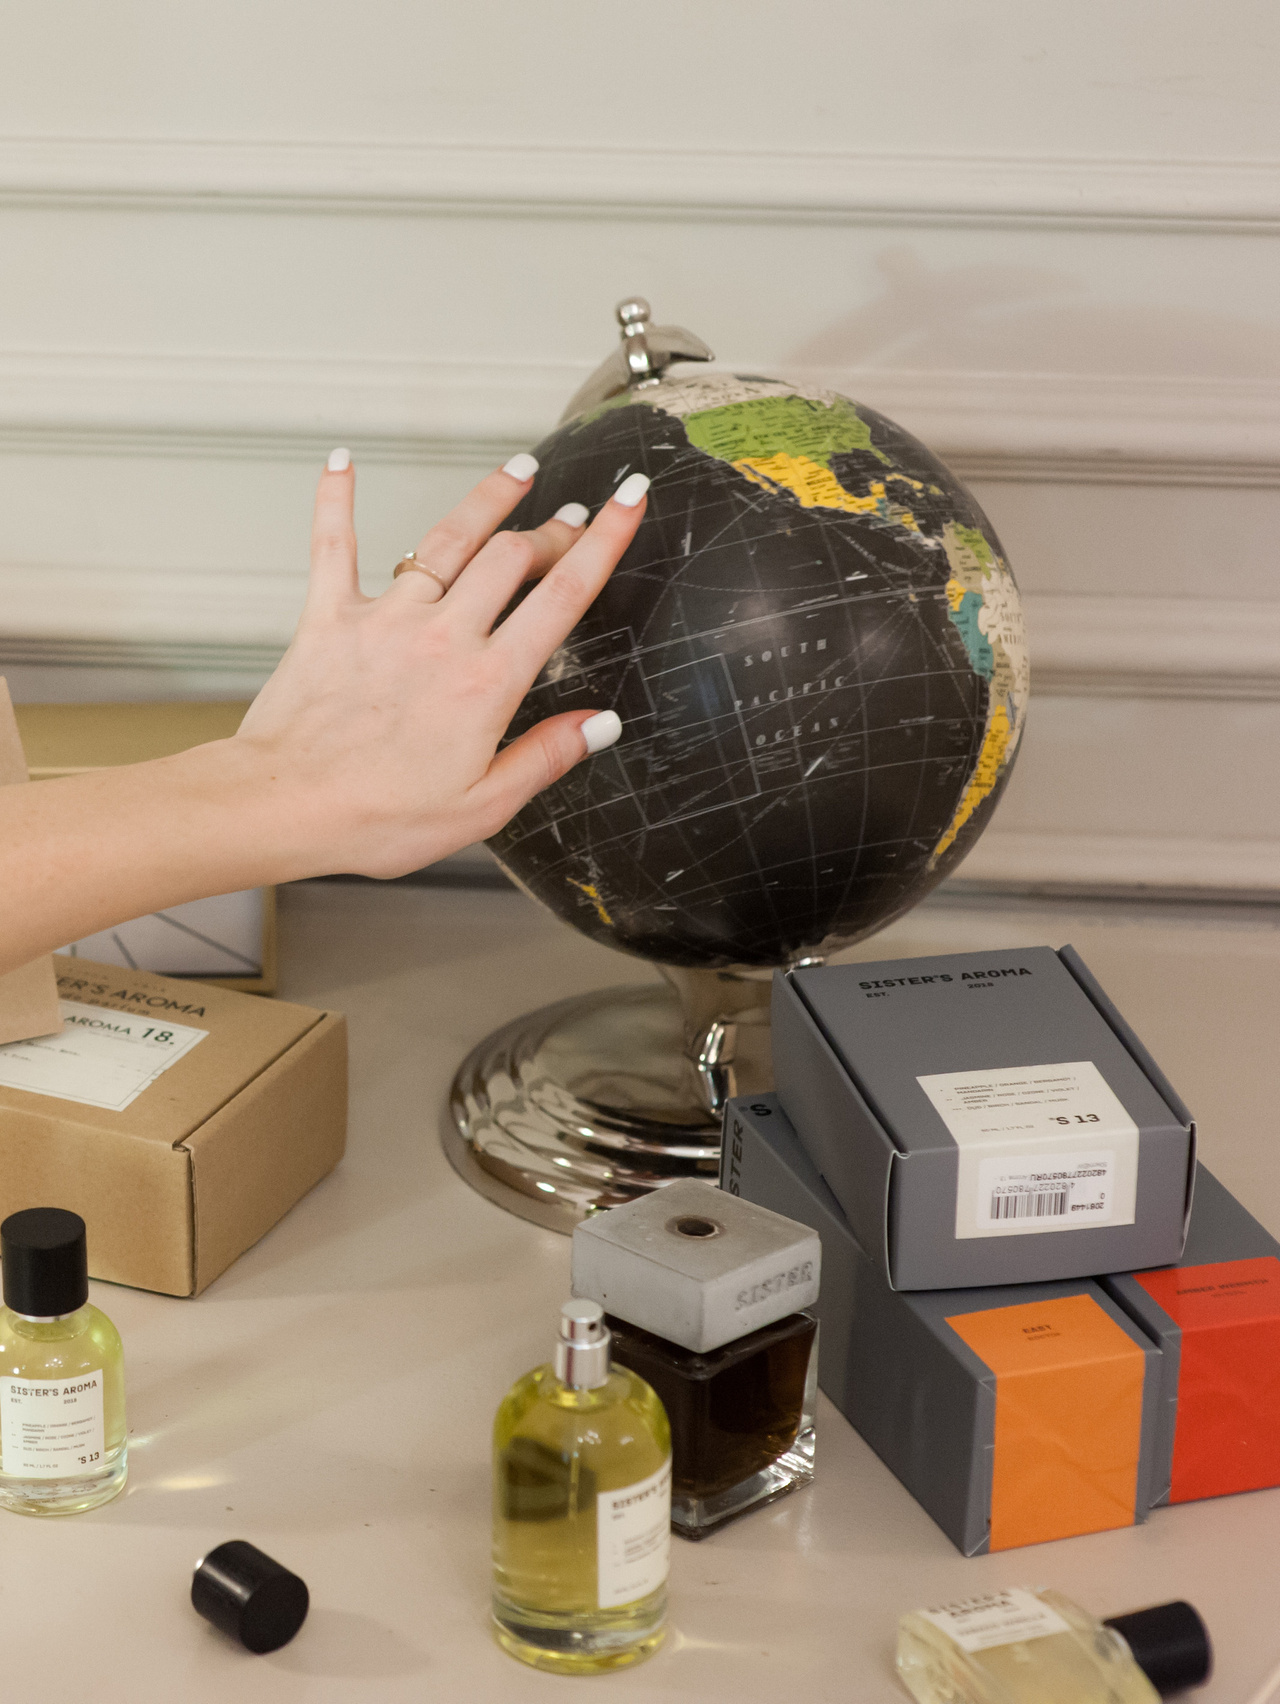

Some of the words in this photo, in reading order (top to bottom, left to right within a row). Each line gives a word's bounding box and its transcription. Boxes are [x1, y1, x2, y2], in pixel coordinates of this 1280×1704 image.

[961, 967, 1033, 981] AROMA
[866, 991, 890, 999] EST.
[110, 989, 207, 1018] AROMA
[64, 1015, 131, 1035] AROMA
[142, 1027, 175, 1045] 18.
[1074, 1113, 1100, 1124] 13
[63, 1380, 97, 1396] AROMA
[63, 1397, 77, 1405] 2018
[89, 1451, 100, 1462] 13
